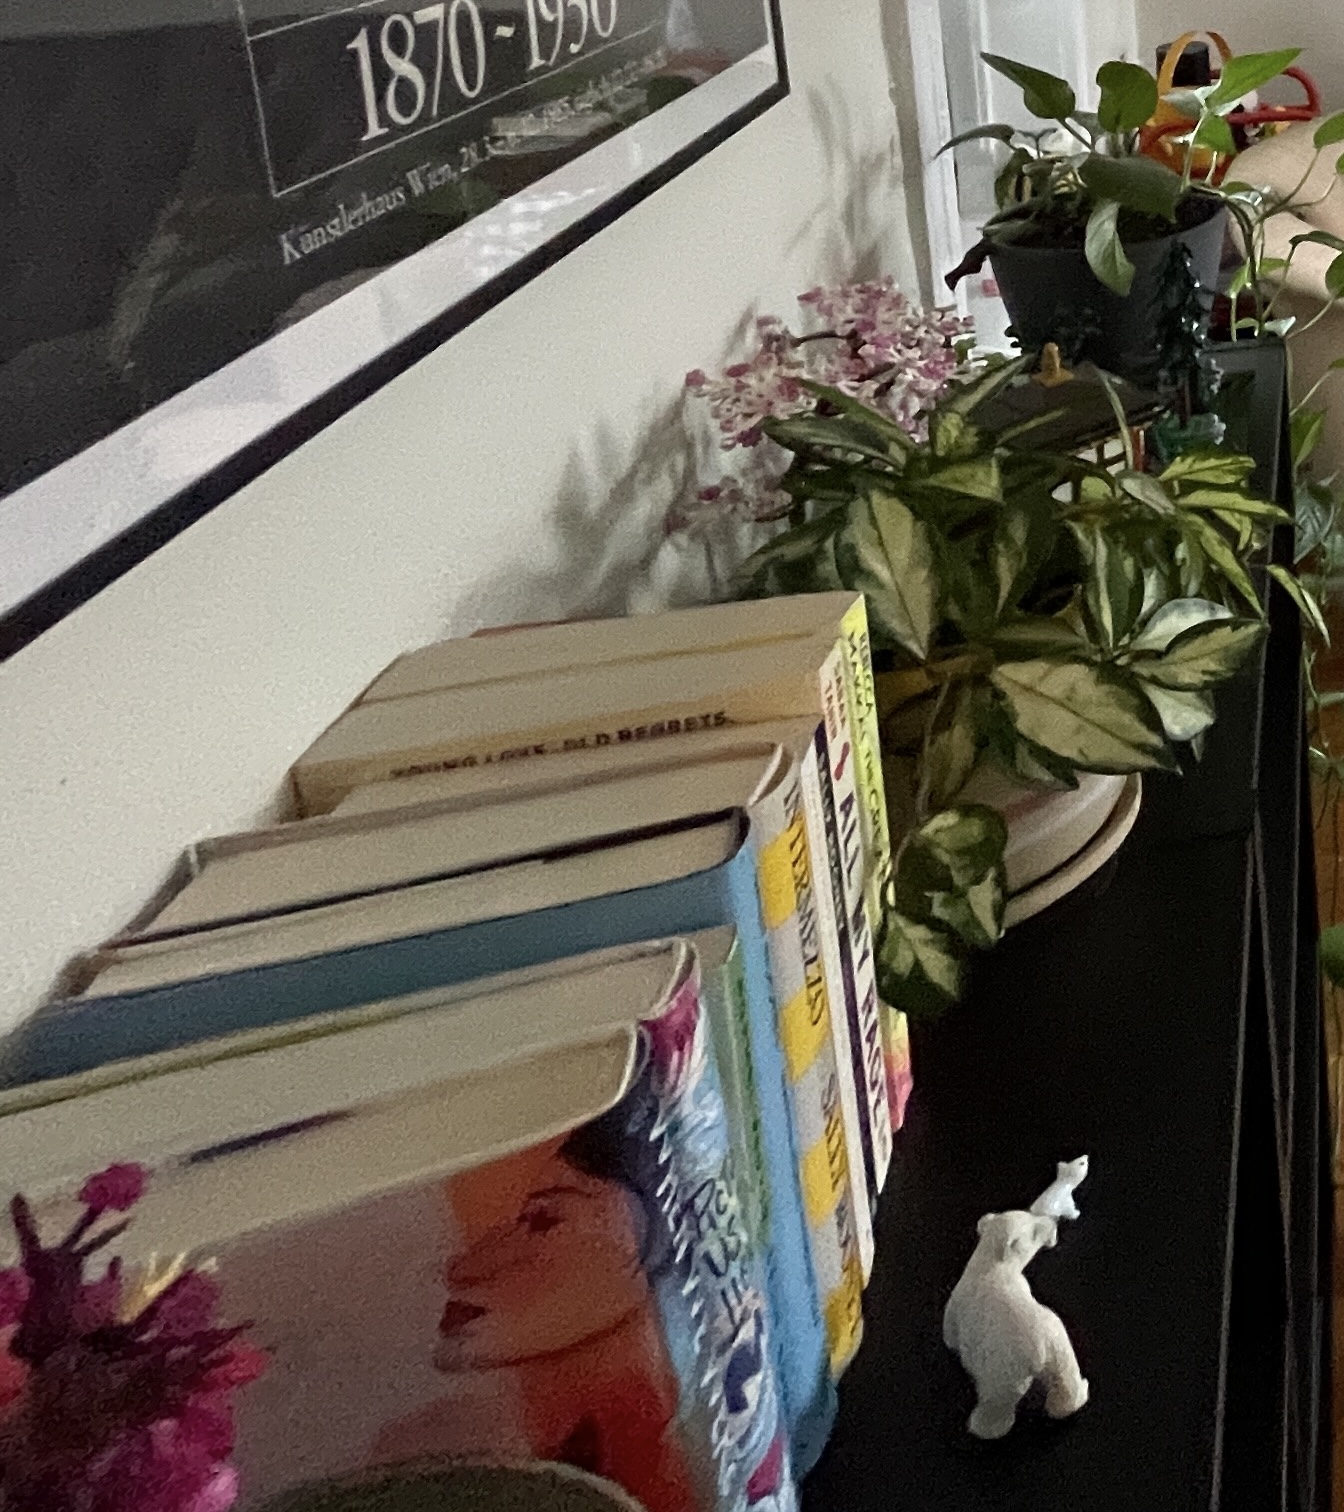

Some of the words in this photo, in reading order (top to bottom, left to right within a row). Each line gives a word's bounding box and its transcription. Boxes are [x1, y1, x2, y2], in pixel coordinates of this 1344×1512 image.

[839, 792, 860, 889] ALL
[852, 891, 870, 970] MY
[861, 980, 887, 1130] RAGE
